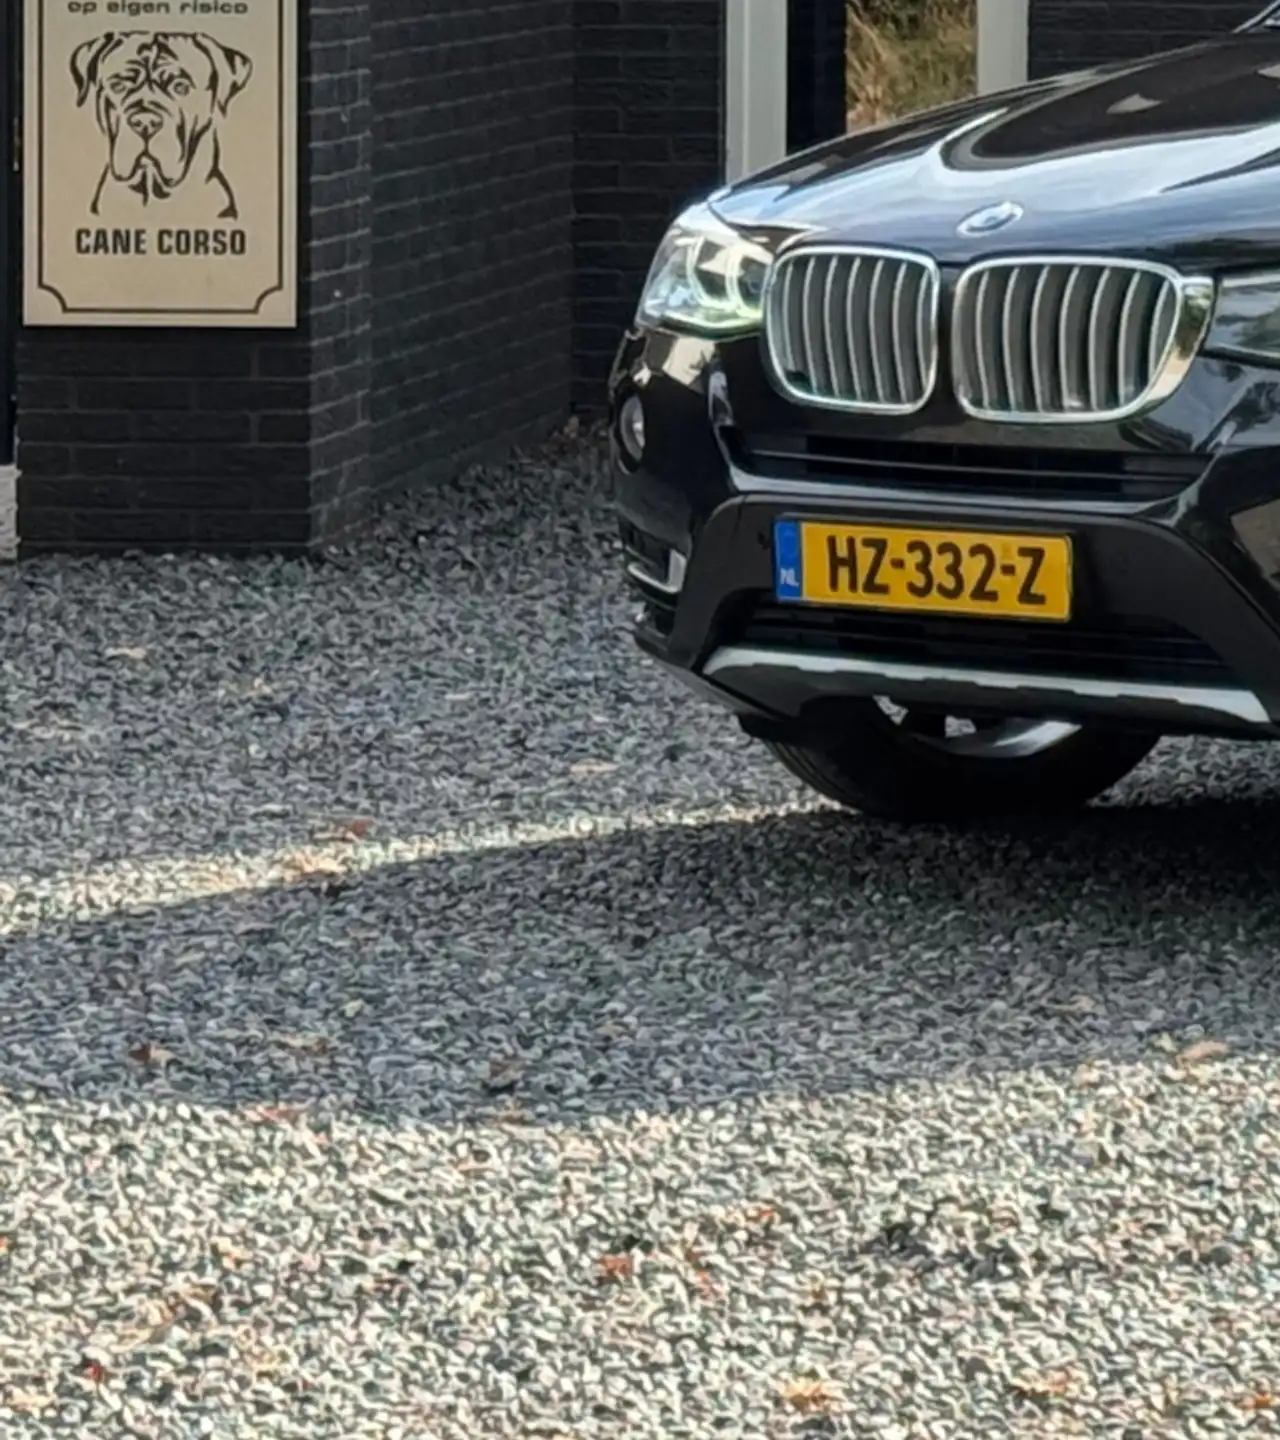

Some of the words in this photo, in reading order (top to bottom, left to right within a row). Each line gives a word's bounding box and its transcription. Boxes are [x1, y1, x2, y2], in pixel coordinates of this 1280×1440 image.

[67, 0, 97, 15] op
[179, 0, 248, 15] risico
[75, 227, 148, 256] CANE
[157, 227, 247, 256] CORSO
[826, 534, 1047, 606] HZ-332-Z
